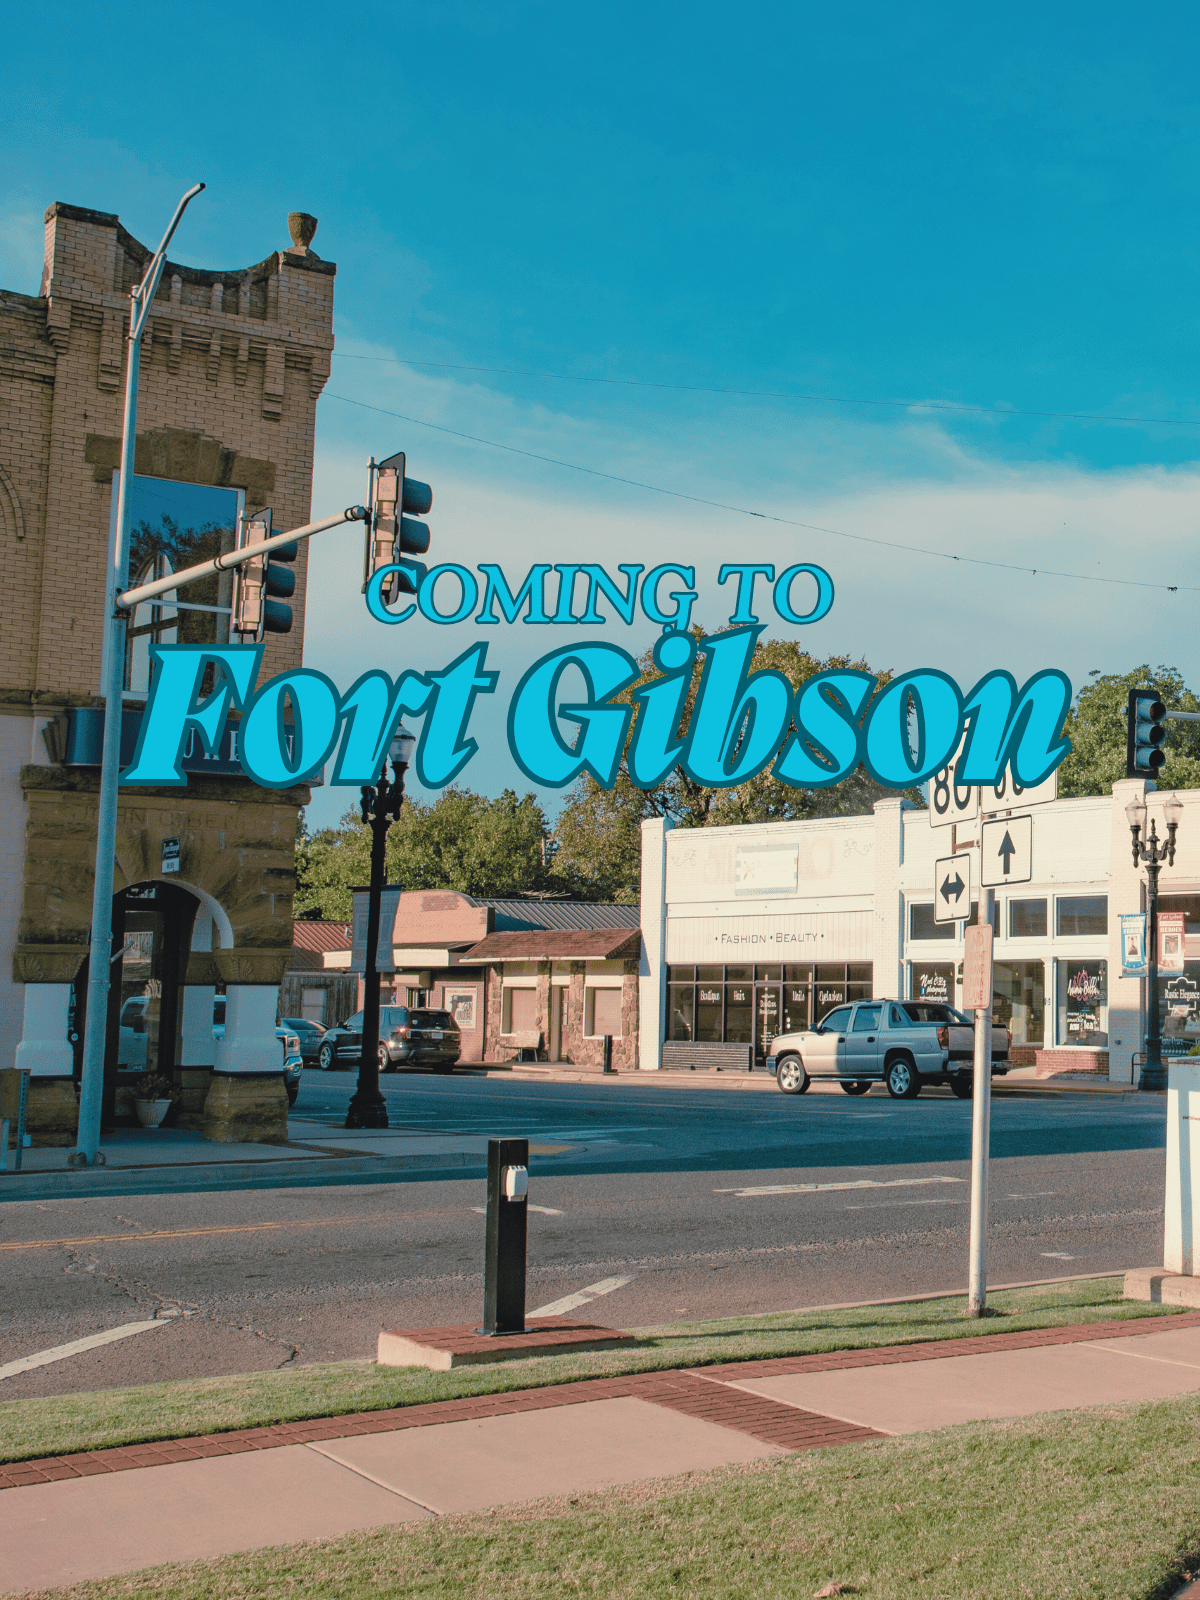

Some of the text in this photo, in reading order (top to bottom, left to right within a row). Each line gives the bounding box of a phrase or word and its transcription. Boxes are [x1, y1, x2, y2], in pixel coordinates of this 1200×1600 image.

[82, 805, 145, 824] JHN
[721, 932, 818, 944] FASHION BEAUTY
[971, 932, 985, 947] NO
[968, 950, 986, 962] RIGHT
[968, 963, 985, 975] HAND
[968, 977, 984, 988] TURN
[733, 989, 745, 1001] Hair
[792, 990, 805, 1001] Nails
[968, 990, 984, 1001] LANE
[1164, 988, 1179, 999] Rustic
